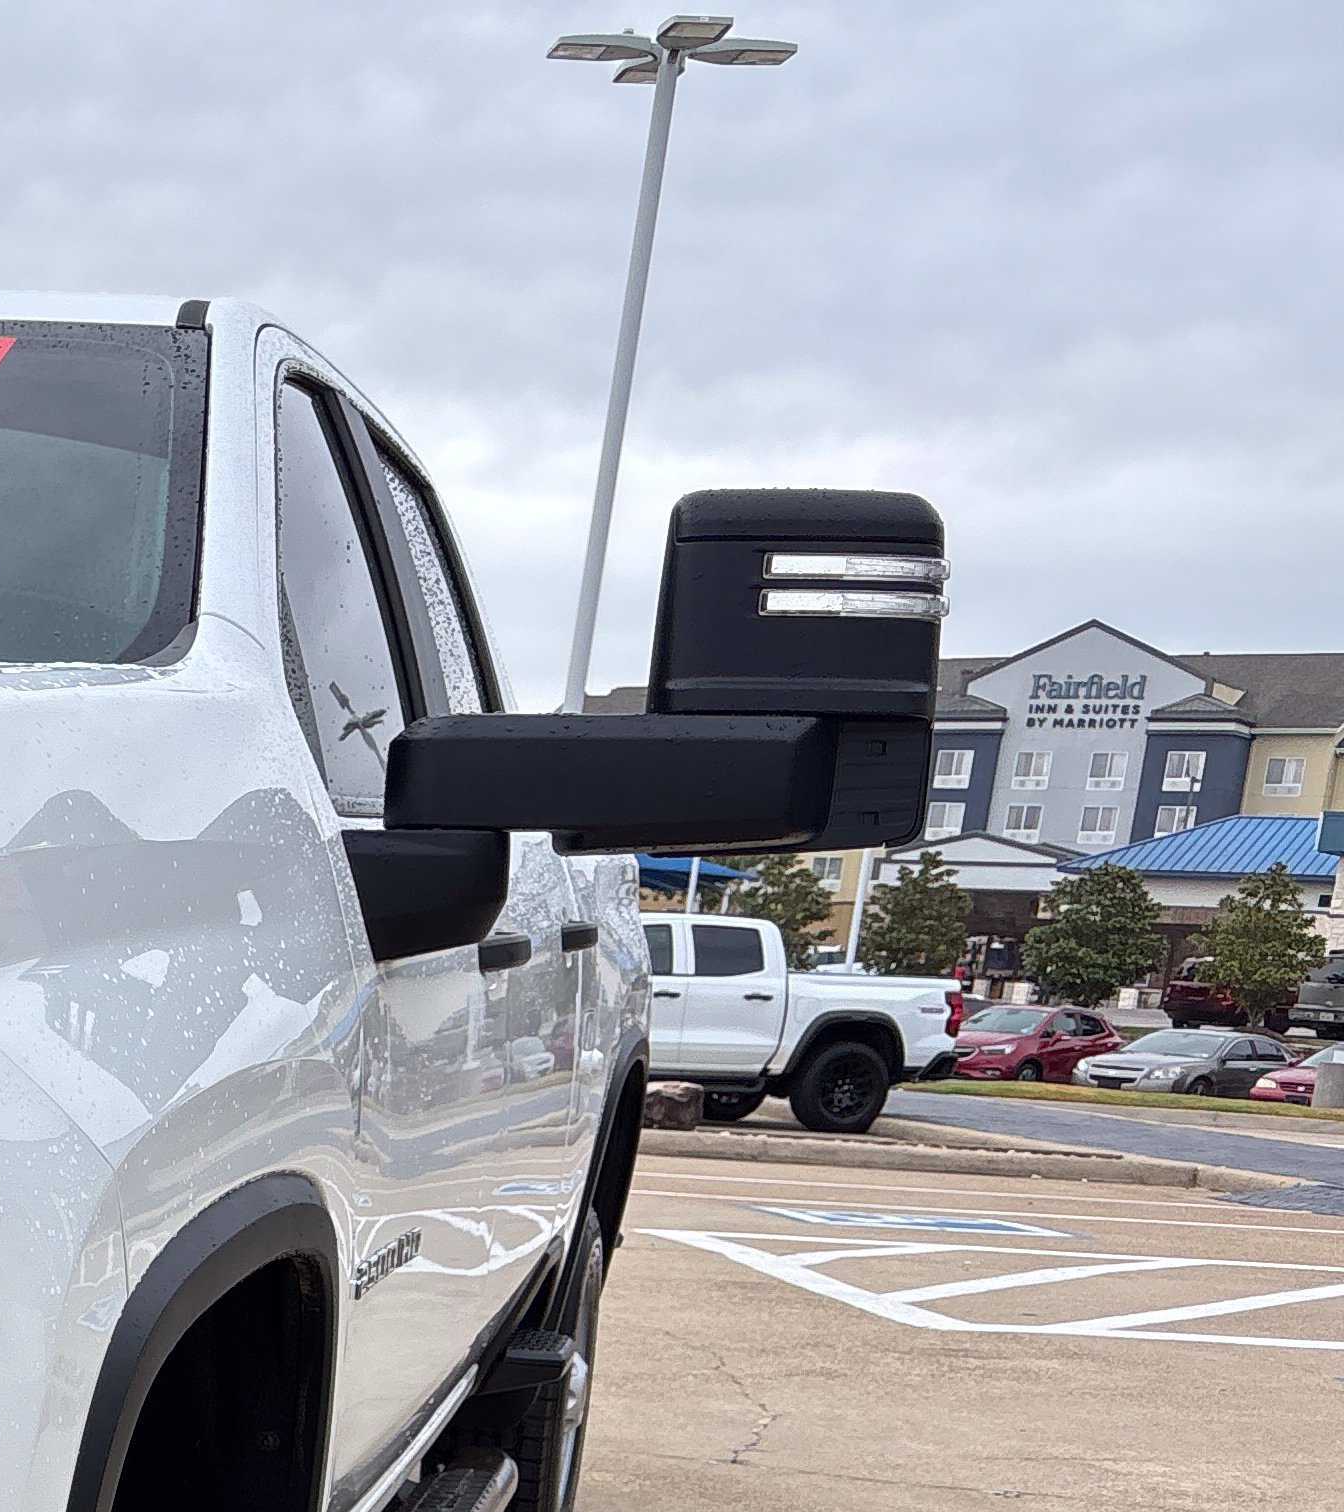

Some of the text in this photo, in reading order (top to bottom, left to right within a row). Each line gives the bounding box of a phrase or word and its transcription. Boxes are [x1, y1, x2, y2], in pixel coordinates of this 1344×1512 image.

[1029, 673, 1148, 700] Fairfield
[1028, 703, 1141, 715] INN & SUITES
[1026, 717, 1139, 729] BY MARRIOTT
